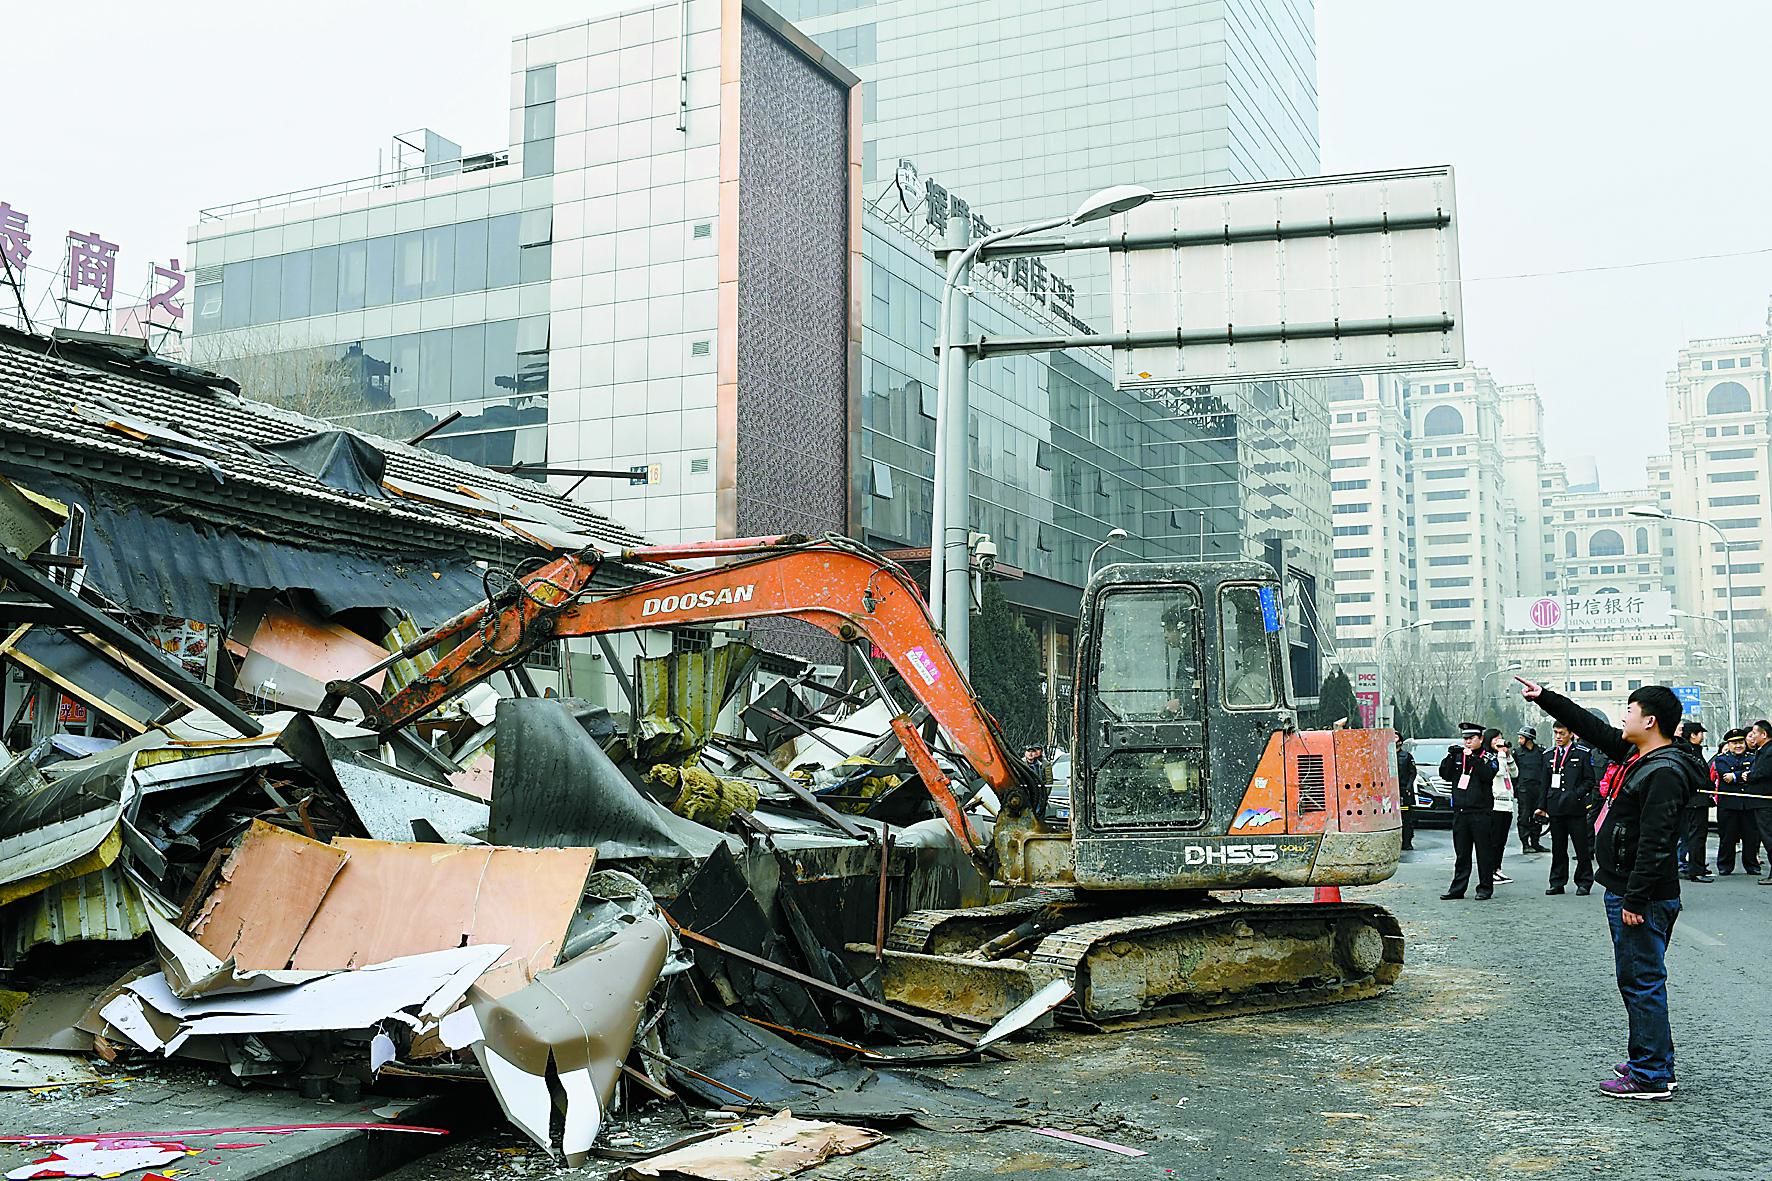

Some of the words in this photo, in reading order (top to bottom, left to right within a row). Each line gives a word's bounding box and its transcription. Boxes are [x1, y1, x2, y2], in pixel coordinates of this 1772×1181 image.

[642, 584, 755, 617] DOOSAN
[1566, 597, 1645, 616] 中信银行
[1358, 673, 1376, 681] PICC
[1184, 844, 1279, 865] DH55
